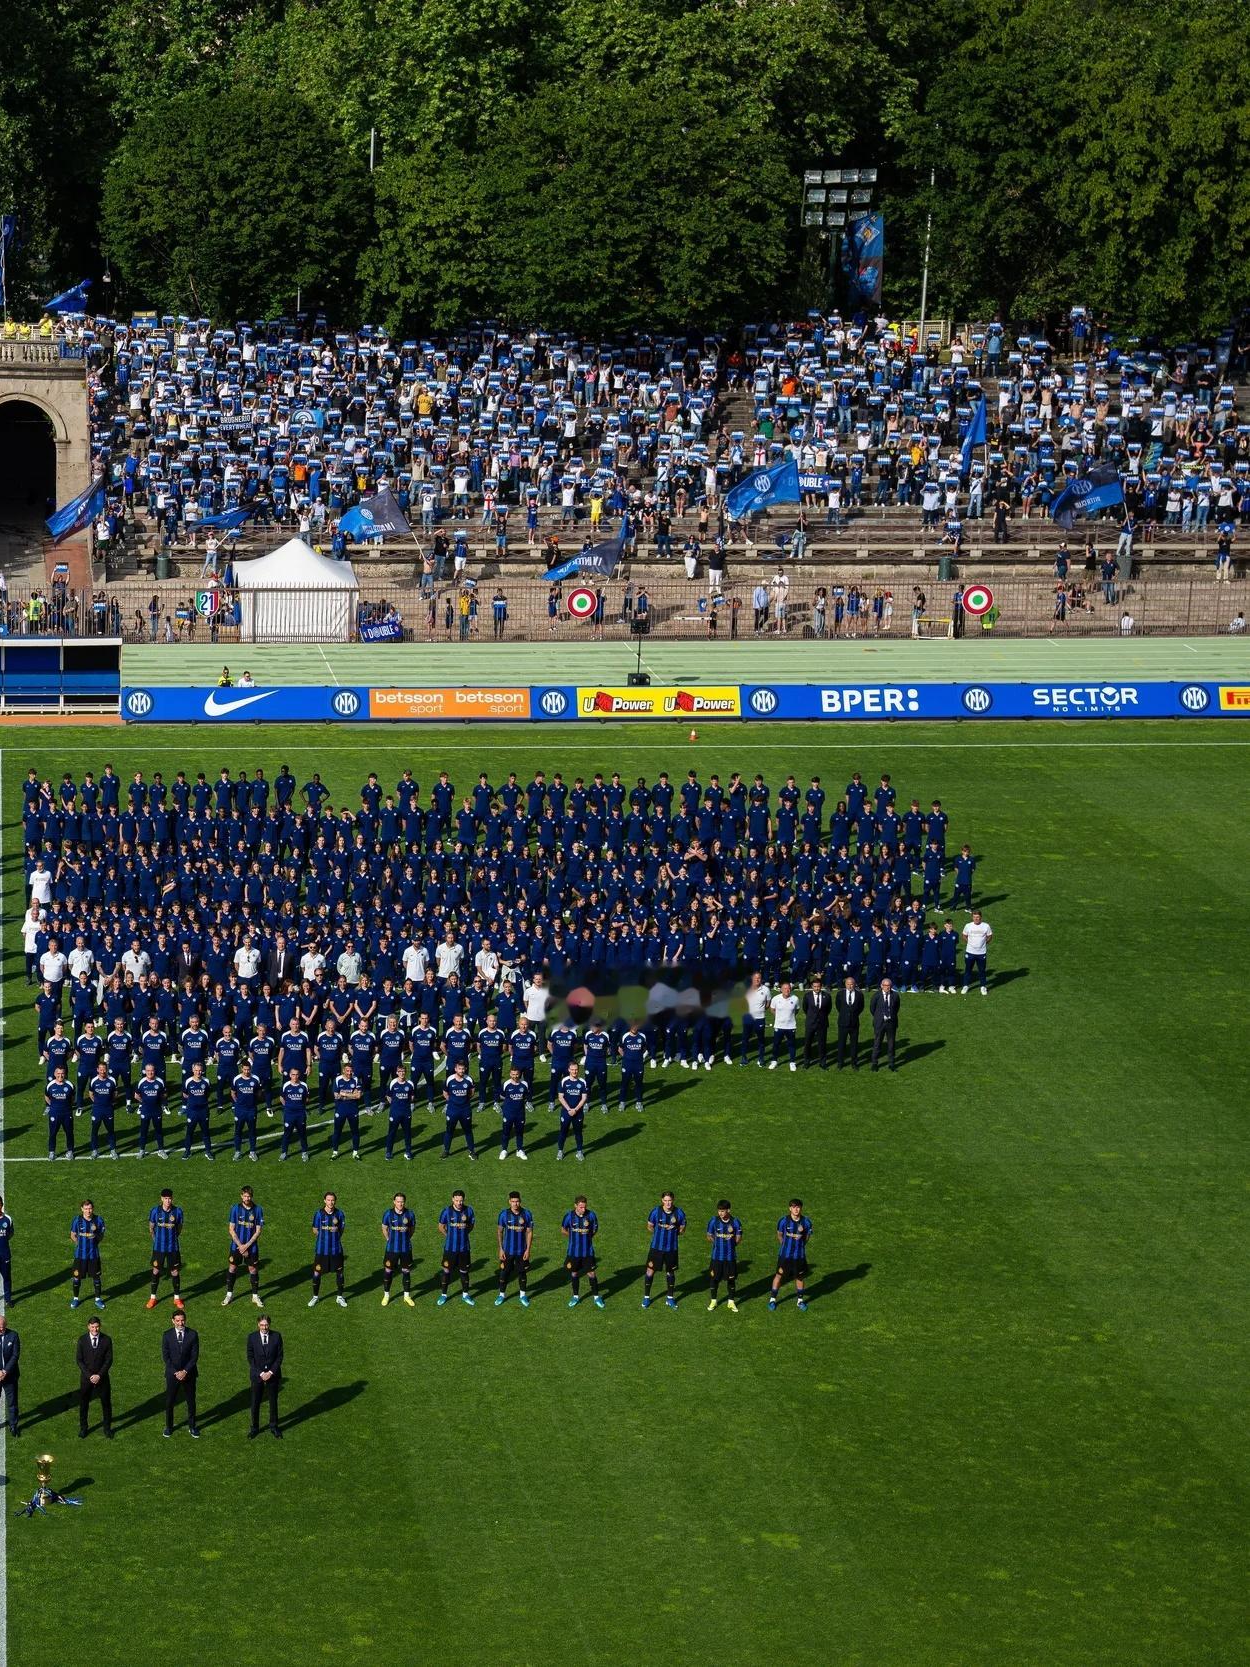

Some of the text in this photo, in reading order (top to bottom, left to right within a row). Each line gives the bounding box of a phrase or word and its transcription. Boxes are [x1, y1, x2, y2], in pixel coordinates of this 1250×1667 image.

[201, 594, 214, 611] 21
[375, 691, 444, 704] betsson
[455, 691, 524, 704] betsson
[1032, 686, 1139, 706] SECTOR
[406, 703, 444, 716] .sport
[486, 702, 524, 715] .sport
